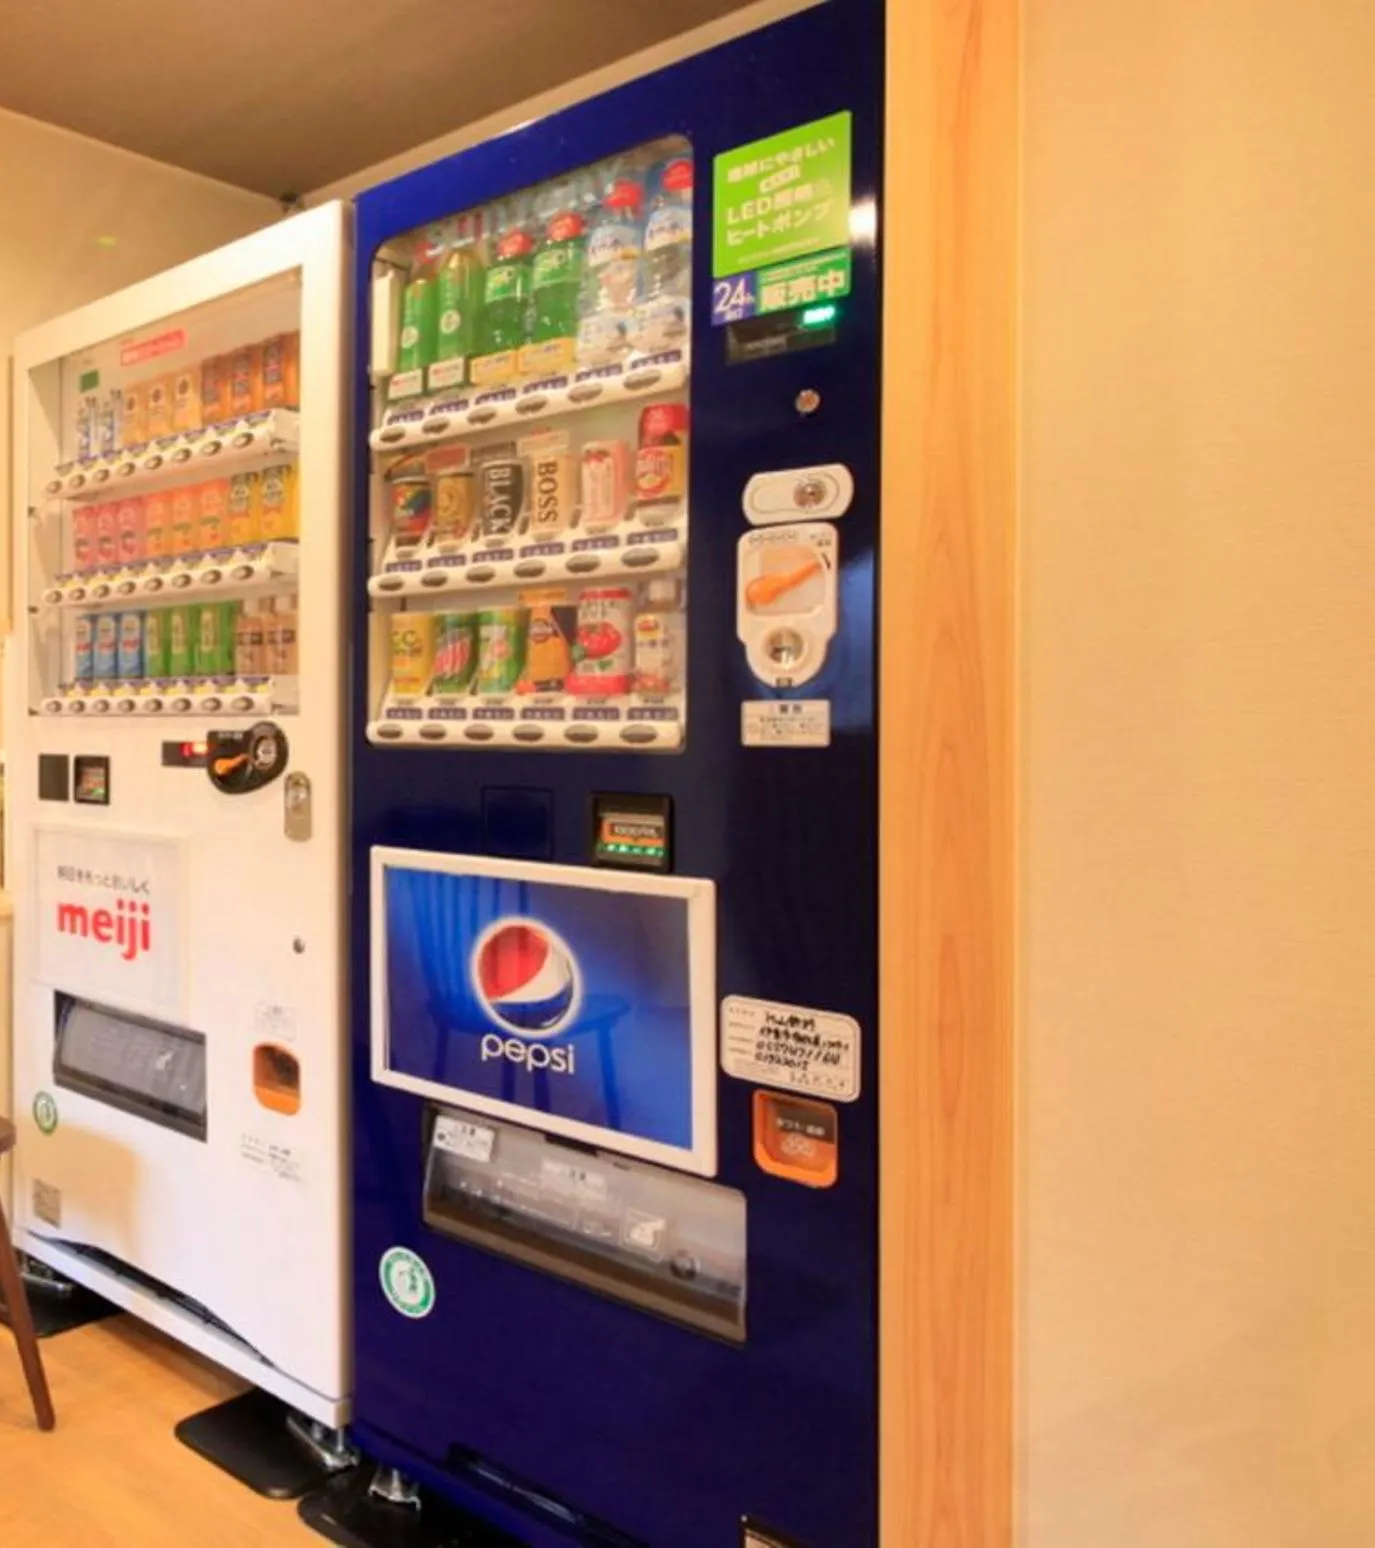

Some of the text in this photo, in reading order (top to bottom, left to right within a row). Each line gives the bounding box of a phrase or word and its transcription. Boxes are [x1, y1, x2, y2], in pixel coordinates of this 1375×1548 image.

[486, 465, 513, 533] BLACK
[538, 460, 558, 523] BOSS
[57, 898, 151, 961] meiji
[481, 1033, 575, 1074] pepsi
